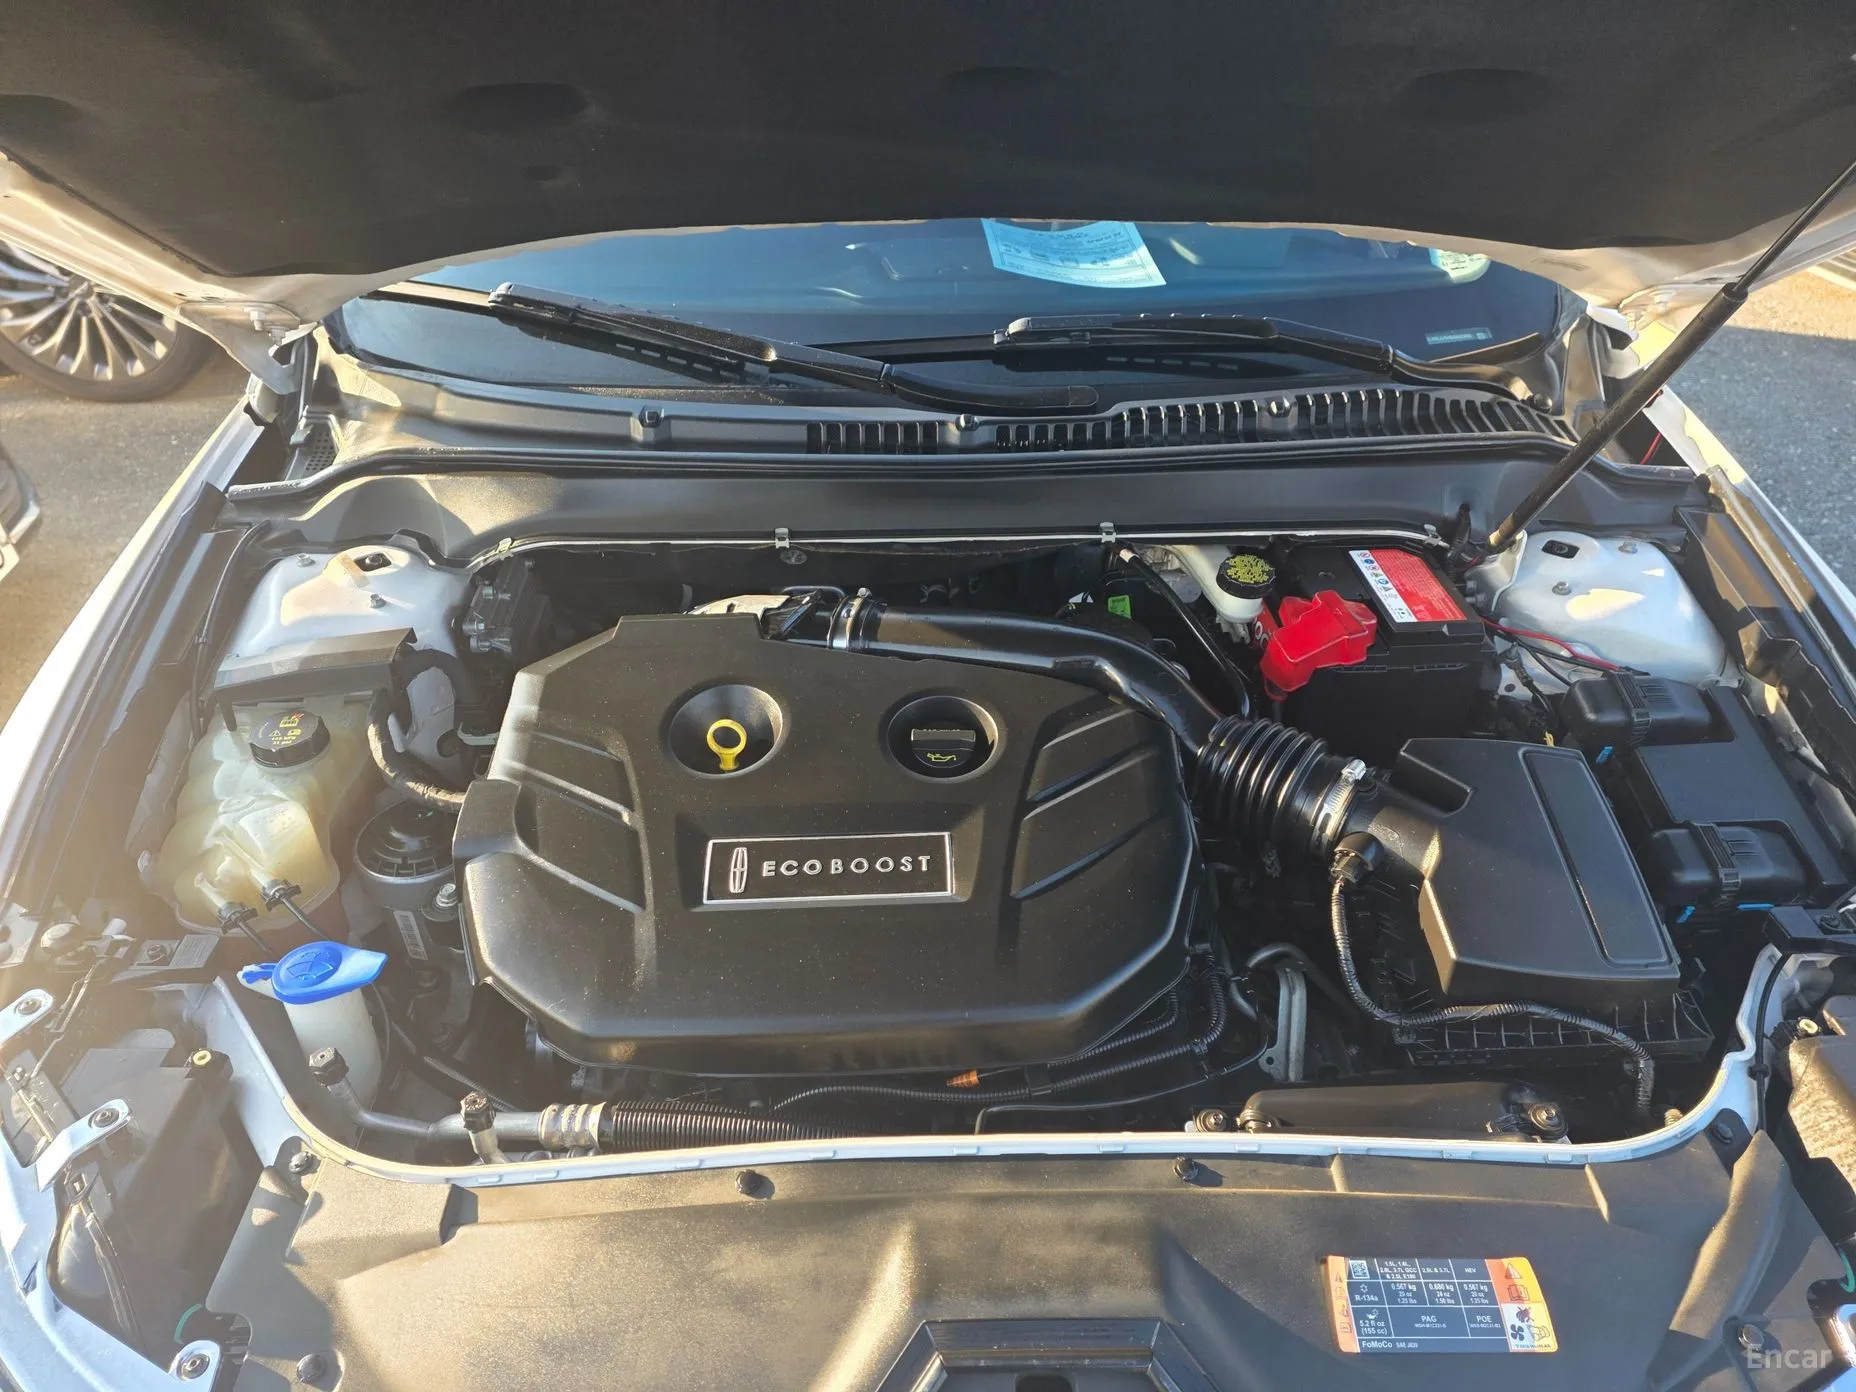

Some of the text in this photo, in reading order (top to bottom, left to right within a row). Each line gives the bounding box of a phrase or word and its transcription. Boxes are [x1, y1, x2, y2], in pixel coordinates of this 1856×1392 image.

[762, 855, 931, 877] ECOBOOST
[1408, 1283, 1417, 1292] kg
[1445, 1283, 1454, 1292] kg
[1479, 1283, 1488, 1292] kg
[1421, 1315, 1437, 1323] PAG
[1476, 1315, 1493, 1323] POE
[1361, 1340, 1393, 1348] FoMoCo
